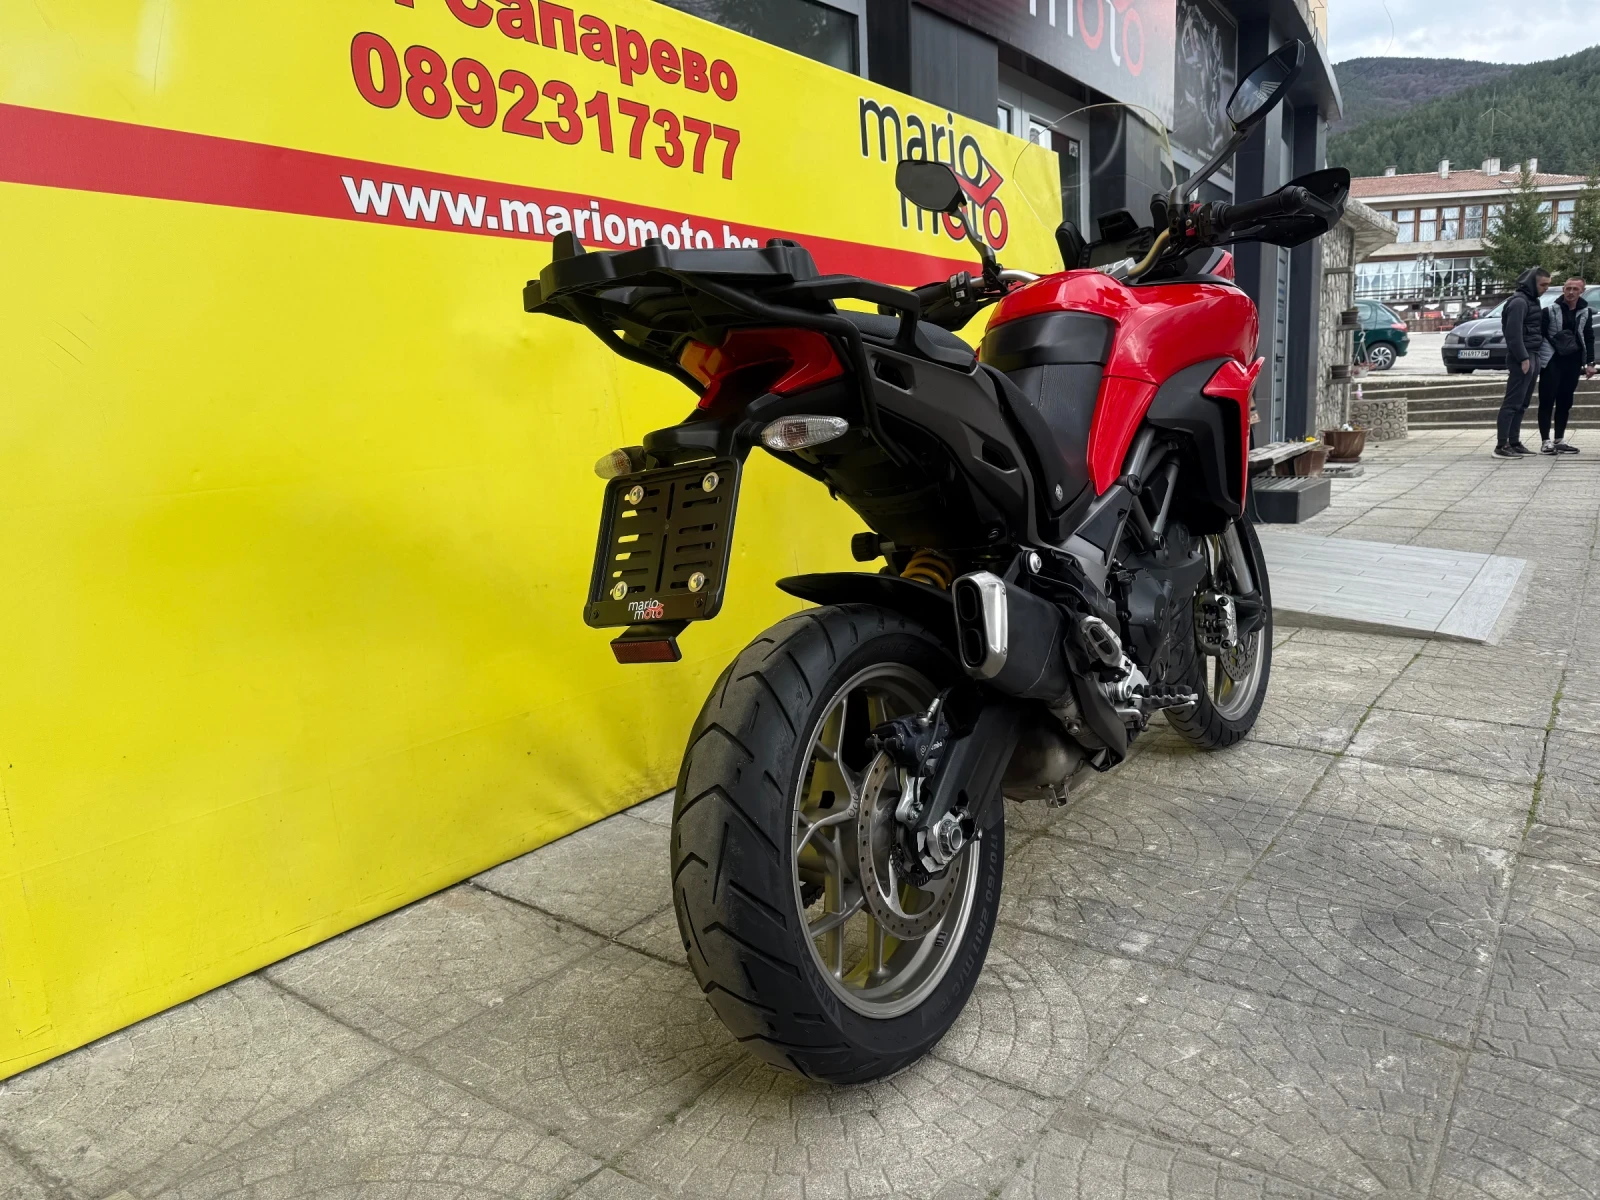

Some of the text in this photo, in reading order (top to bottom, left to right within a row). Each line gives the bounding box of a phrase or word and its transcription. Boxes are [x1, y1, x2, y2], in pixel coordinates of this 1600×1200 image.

[350, 31, 741, 180] 0892317377
[859, 97, 983, 186] mario
[628, 598, 659, 611] mario
